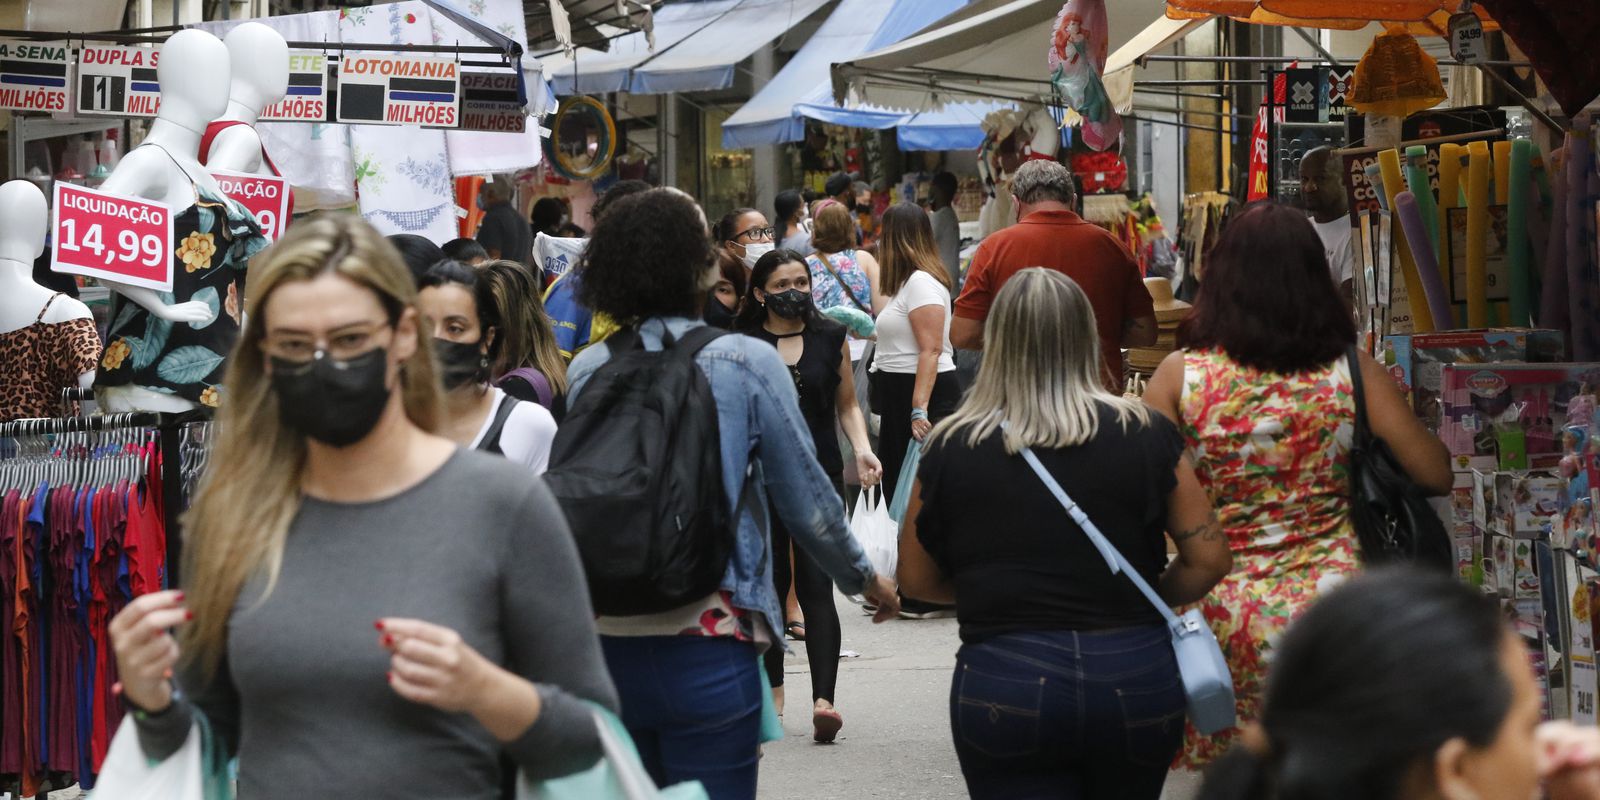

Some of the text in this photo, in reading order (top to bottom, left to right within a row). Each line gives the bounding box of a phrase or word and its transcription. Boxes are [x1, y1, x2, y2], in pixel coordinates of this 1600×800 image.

[83, 49, 143, 66] DUPLA
[343, 58, 456, 78] LOTOMANIA
[0, 87, 65, 110] MILHÕES
[96, 77, 107, 110] 1
[386, 101, 455, 125] MILHÕES
[466, 102, 496, 110] CORRE
[463, 112, 523, 131] MILHÕES
[63, 193, 163, 225] LIQUIDAÇÃO
[60, 218, 163, 267] 14,99
